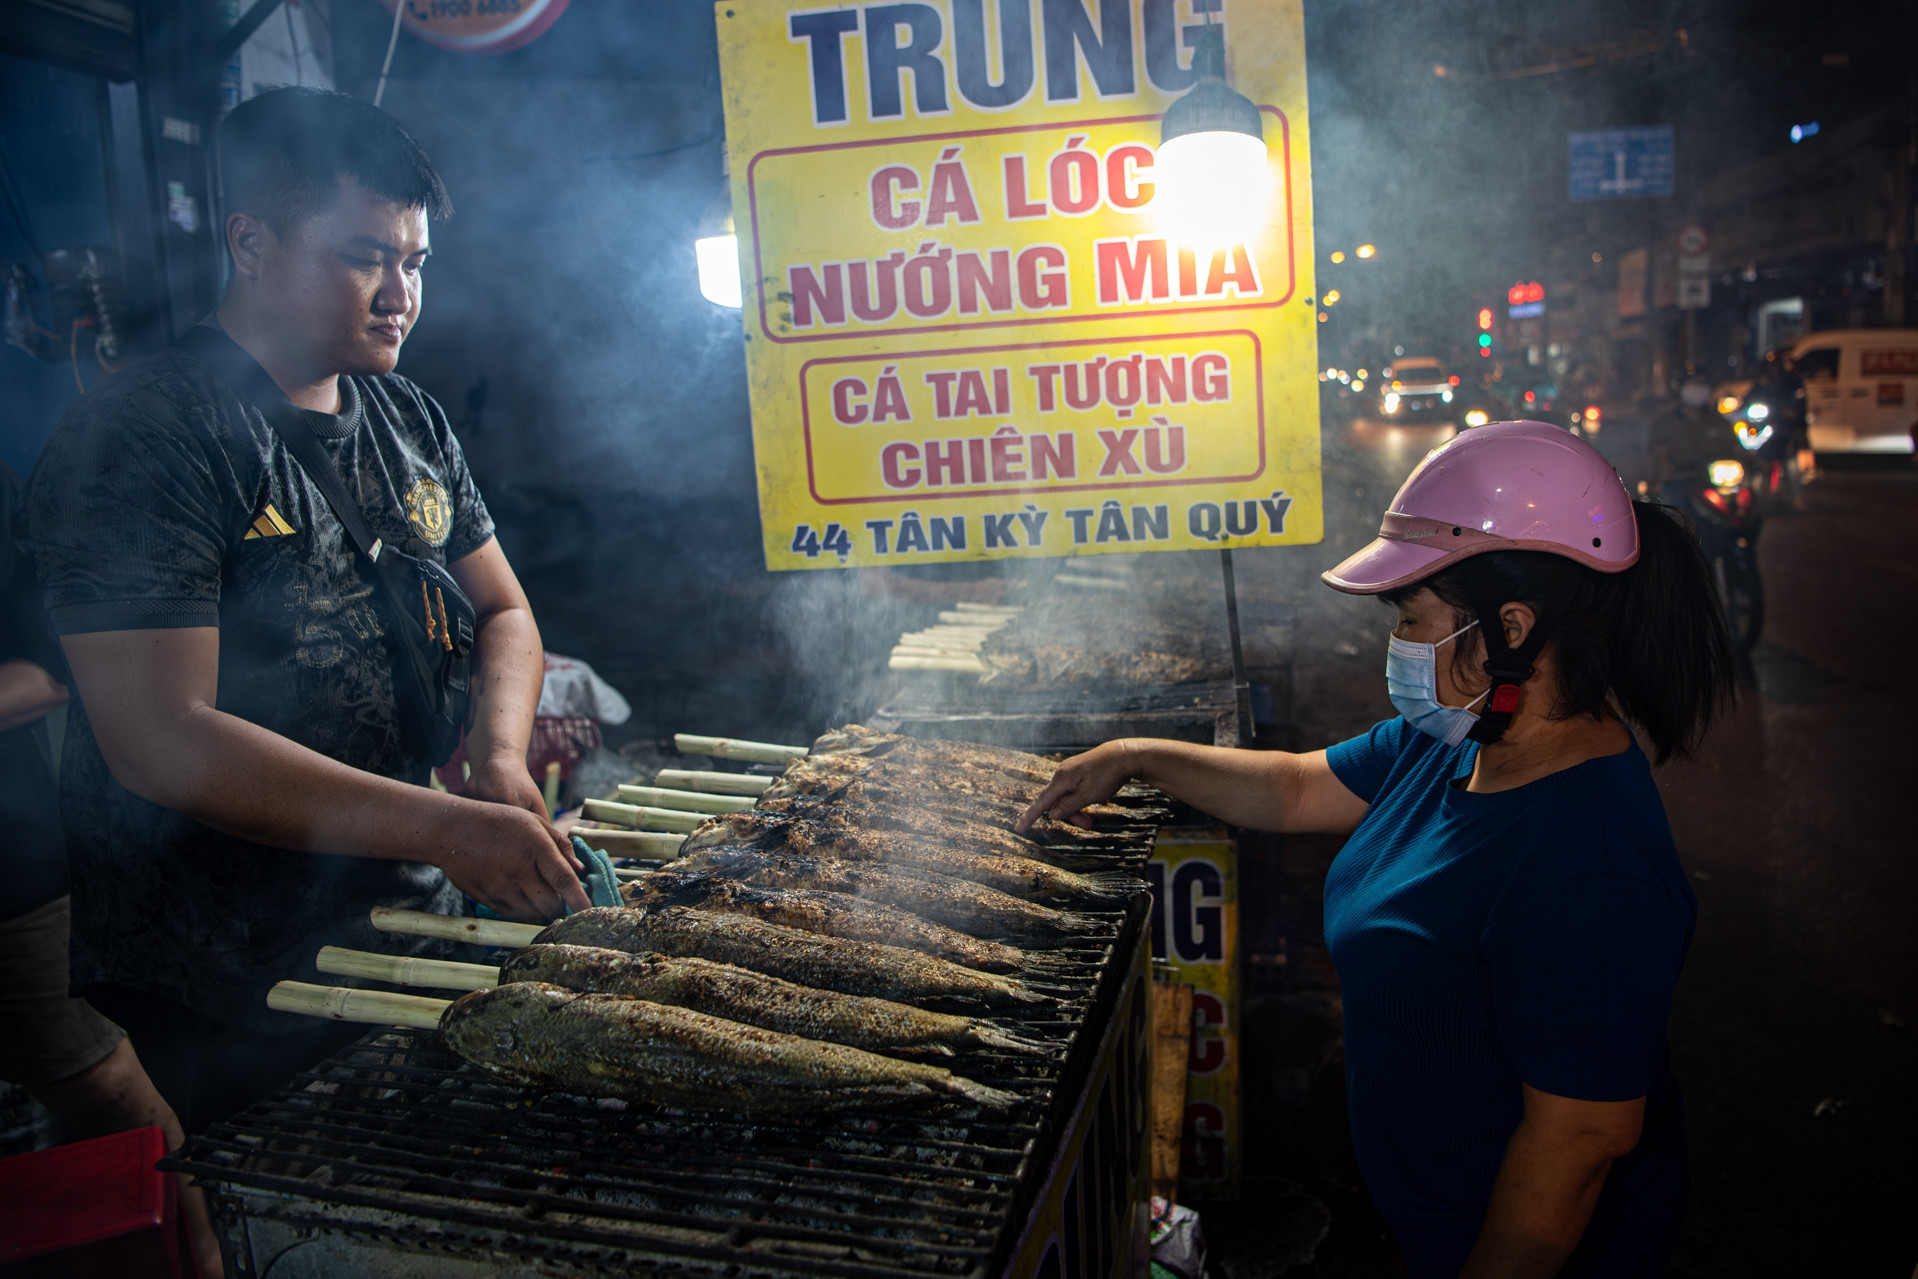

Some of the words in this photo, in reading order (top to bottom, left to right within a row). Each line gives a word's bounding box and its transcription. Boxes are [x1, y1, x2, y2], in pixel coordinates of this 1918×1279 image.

[790, 0, 1224, 123] TRUNG
[871, 147, 980, 229] CÁ
[1004, 137, 1155, 219] LÓC
[789, 242, 1068, 327] NƯỚNG
[833, 366, 911, 424] CÁ
[925, 368, 1011, 418] TAI
[1028, 354, 1229, 418] TƯỢNG
[881, 426, 1076, 489] CHIÊN
[1097, 417, 1186, 477] XÙ
[791, 523, 852, 557] 44
[865, 511, 966, 554] TÂN
[983, 504, 1049, 549] KỲ
[1065, 500, 1170, 544] TÂN
[1188, 491, 1292, 541] QUÝ
